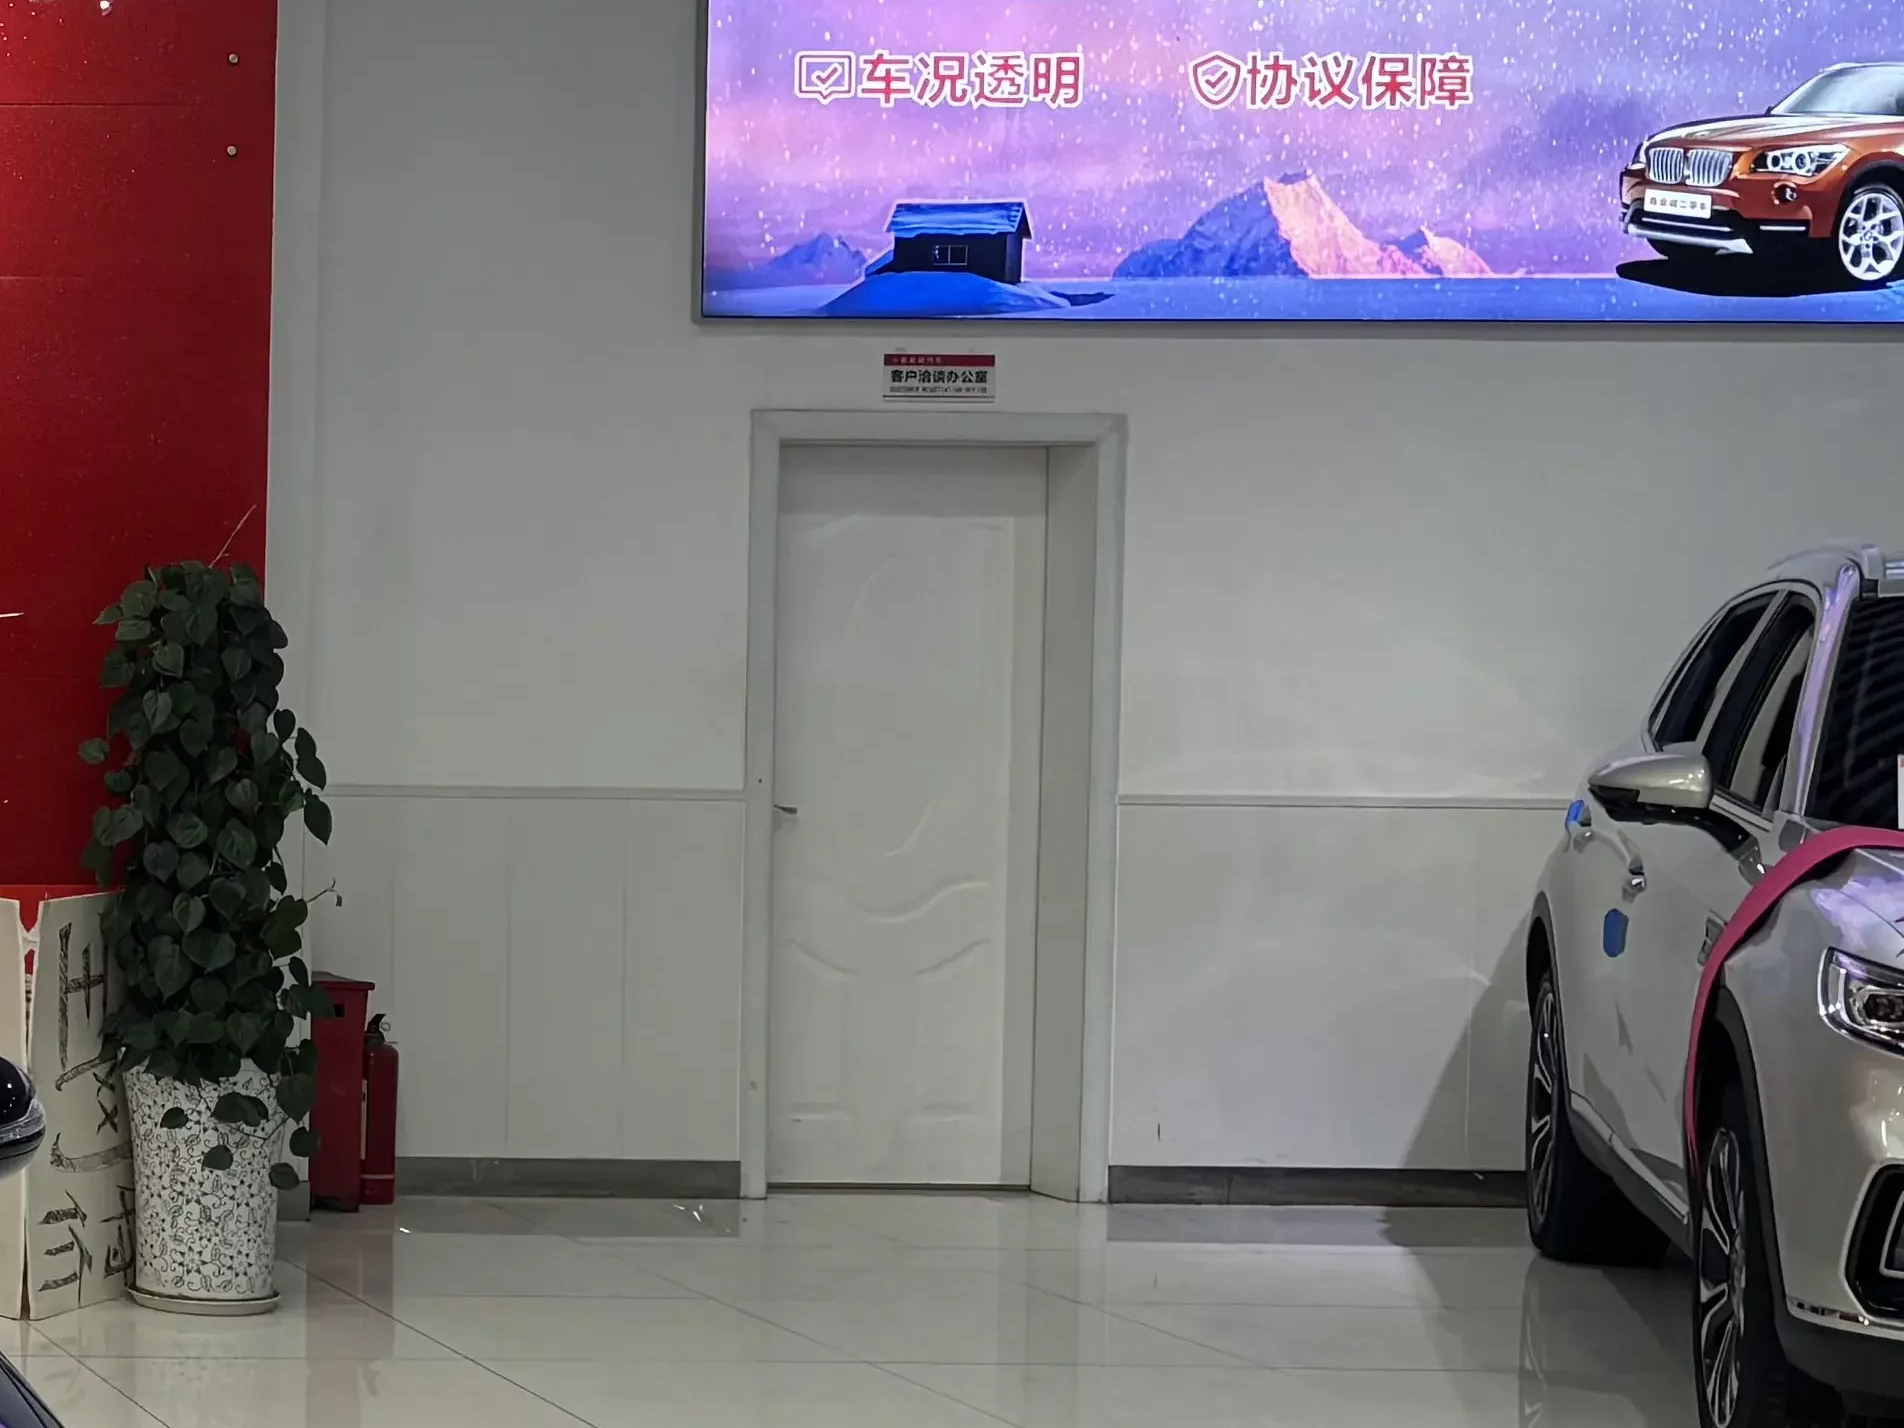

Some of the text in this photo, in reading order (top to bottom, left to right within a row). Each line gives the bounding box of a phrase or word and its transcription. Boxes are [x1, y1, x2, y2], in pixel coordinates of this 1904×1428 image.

[857, 50, 1475, 110] 车况透明 协议保障
[891, 369, 988, 383] 客户洽谈办公室
